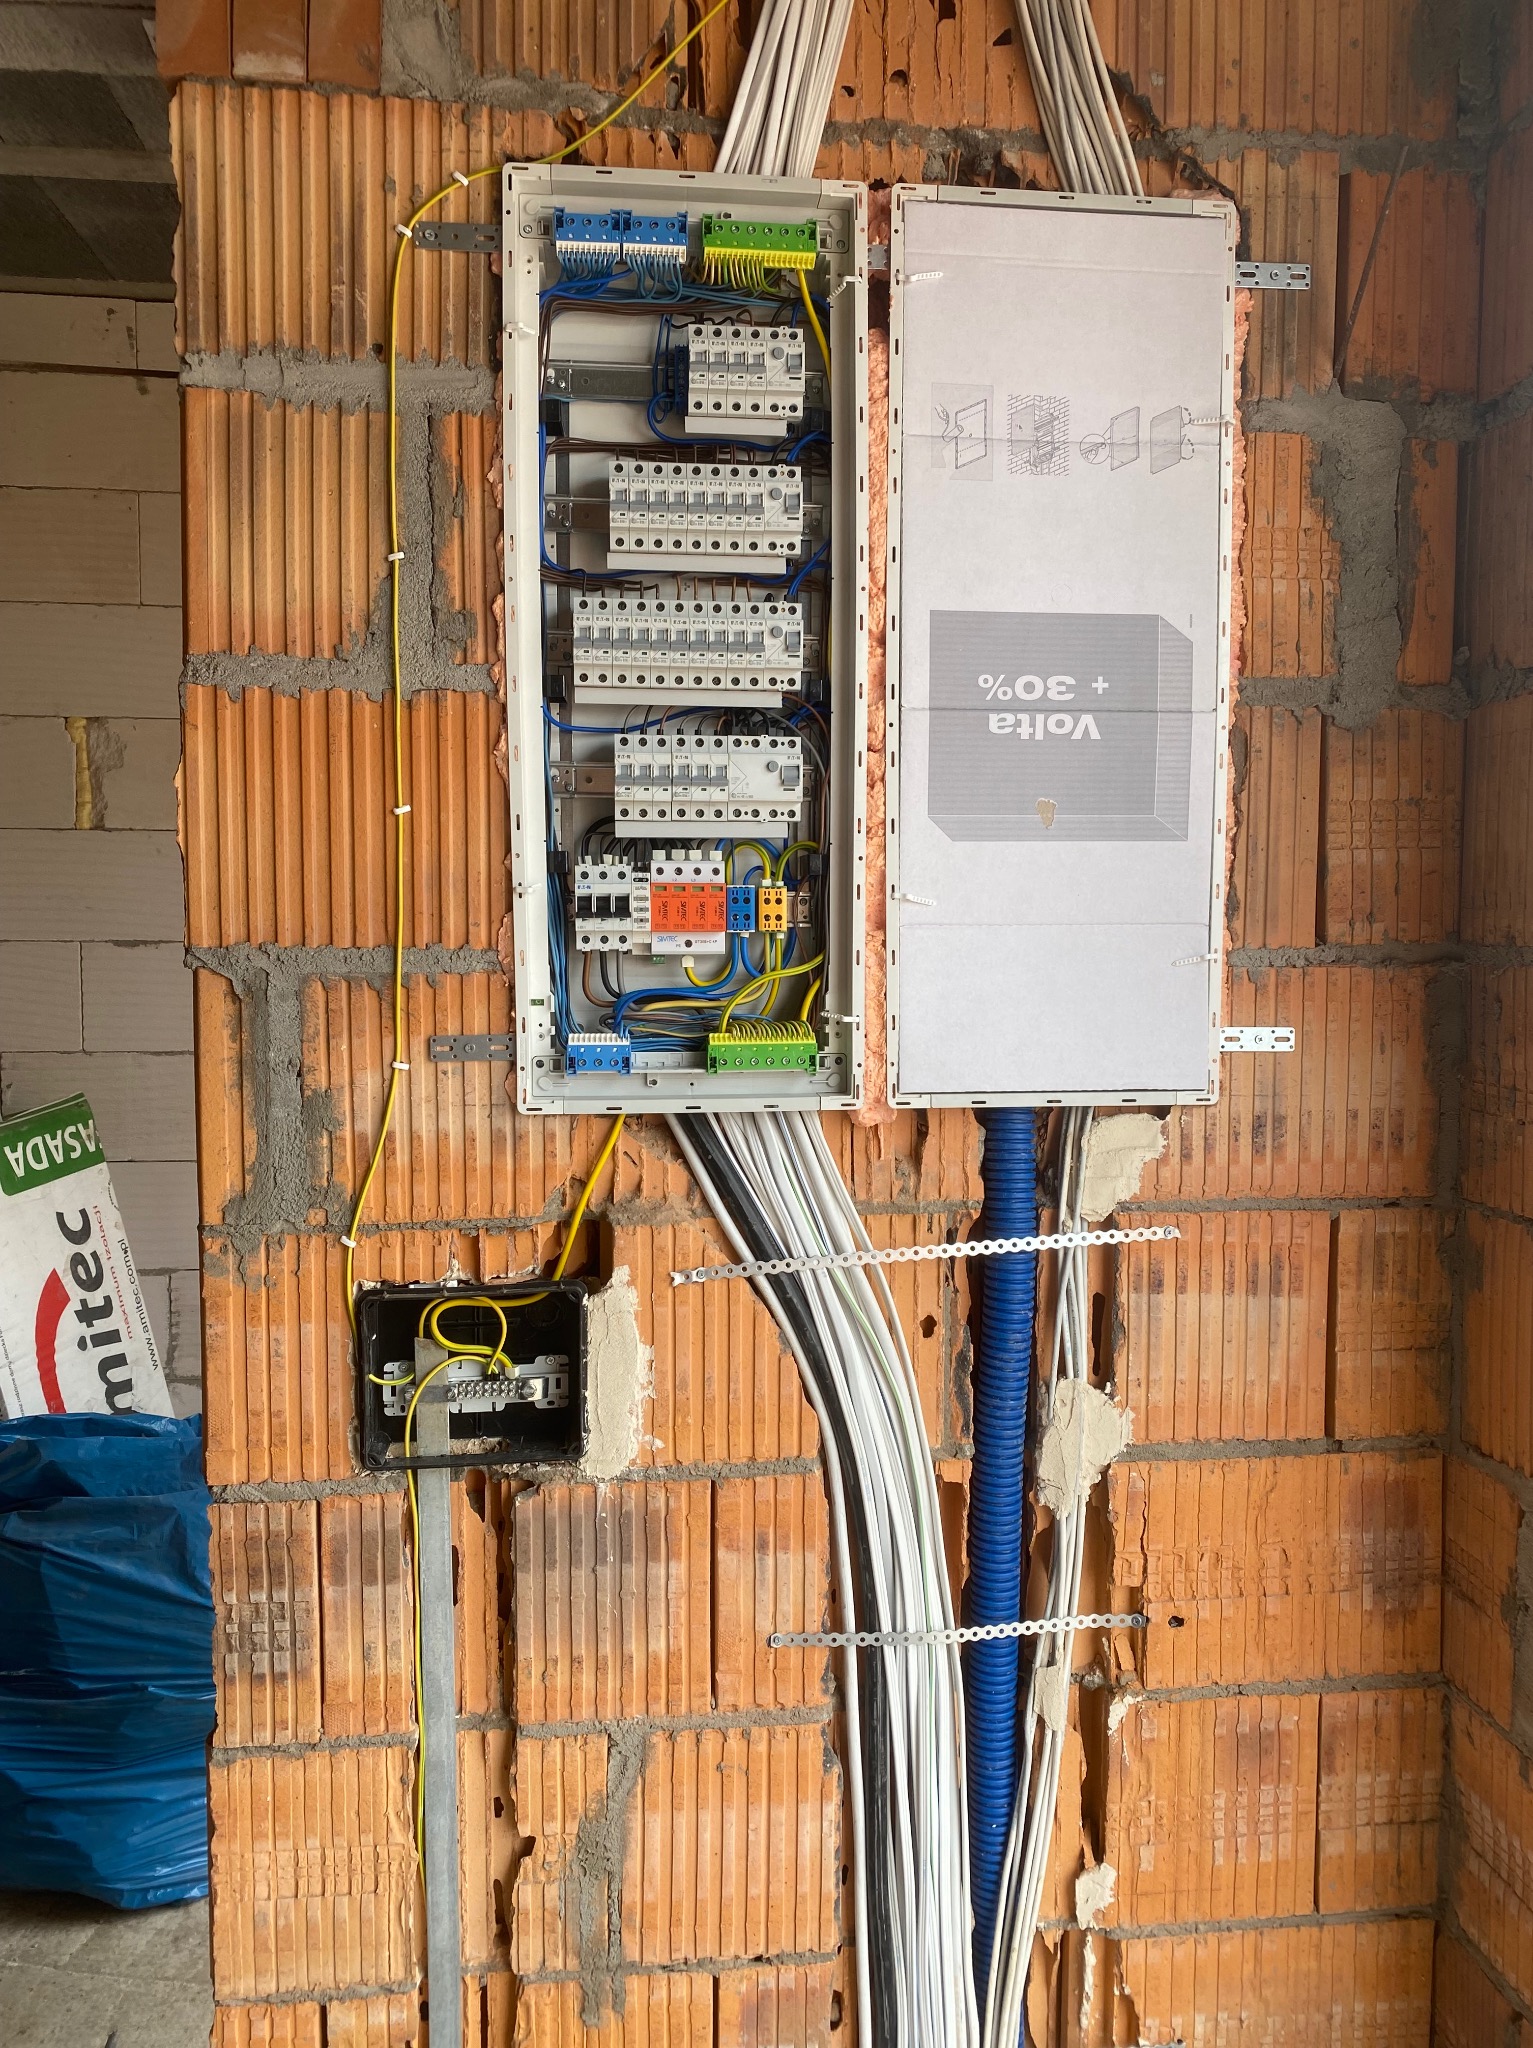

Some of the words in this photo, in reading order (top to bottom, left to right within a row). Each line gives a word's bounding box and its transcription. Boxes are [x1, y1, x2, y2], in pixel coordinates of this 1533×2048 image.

[977, 674, 1076, 701] 30%
[988, 713, 1101, 740] Volta
[3, 1119, 102, 1179] ASADA
[93, 1205, 112, 1261] izolacji
[110, 1266, 133, 1340] maximum
